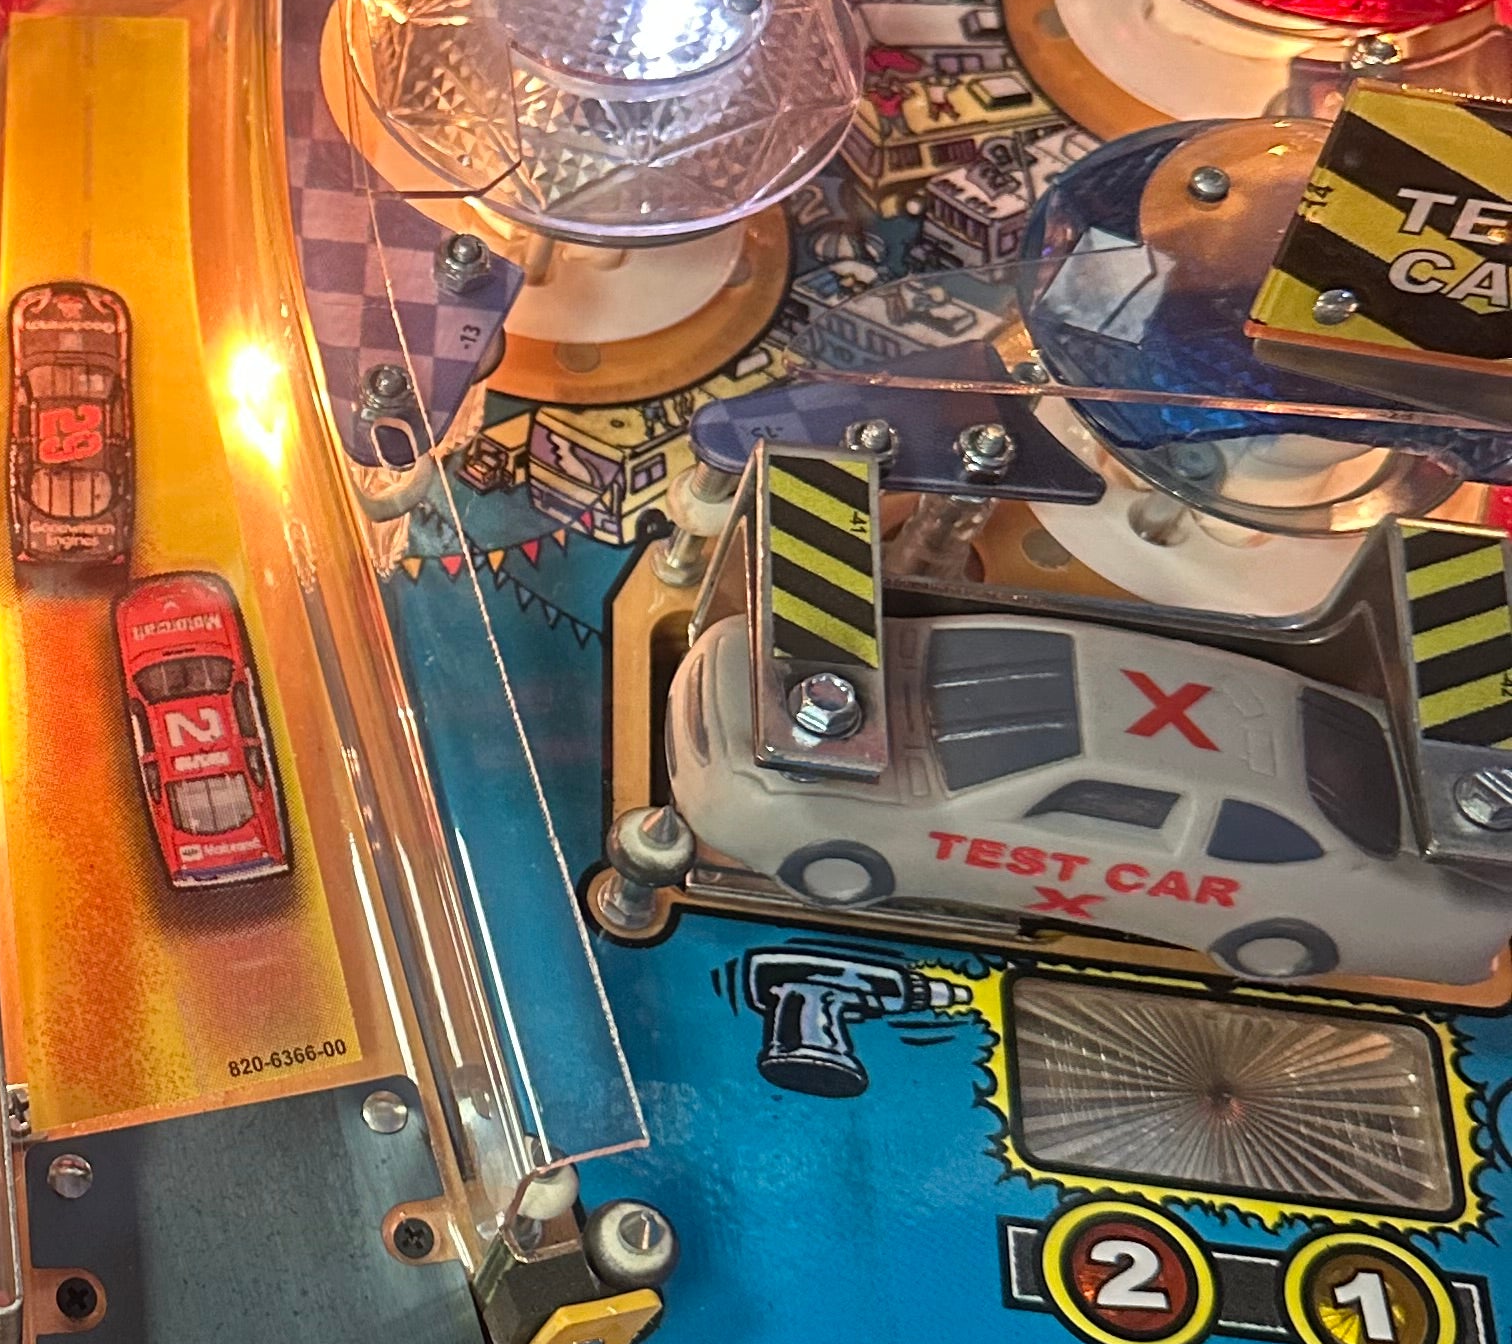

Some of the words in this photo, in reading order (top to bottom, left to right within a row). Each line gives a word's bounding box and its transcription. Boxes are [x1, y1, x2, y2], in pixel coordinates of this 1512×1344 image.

[1397, 186, 1512, 246] TE
[1387, 248, 1512, 307] CA
[38, 404, 103, 464] 29
[929, 831, 1089, 882] TEST
[1105, 863, 1242, 908] CAR
[228, 1038, 347, 1078] 820-6366-00
[1092, 1237, 1172, 1312] 2
